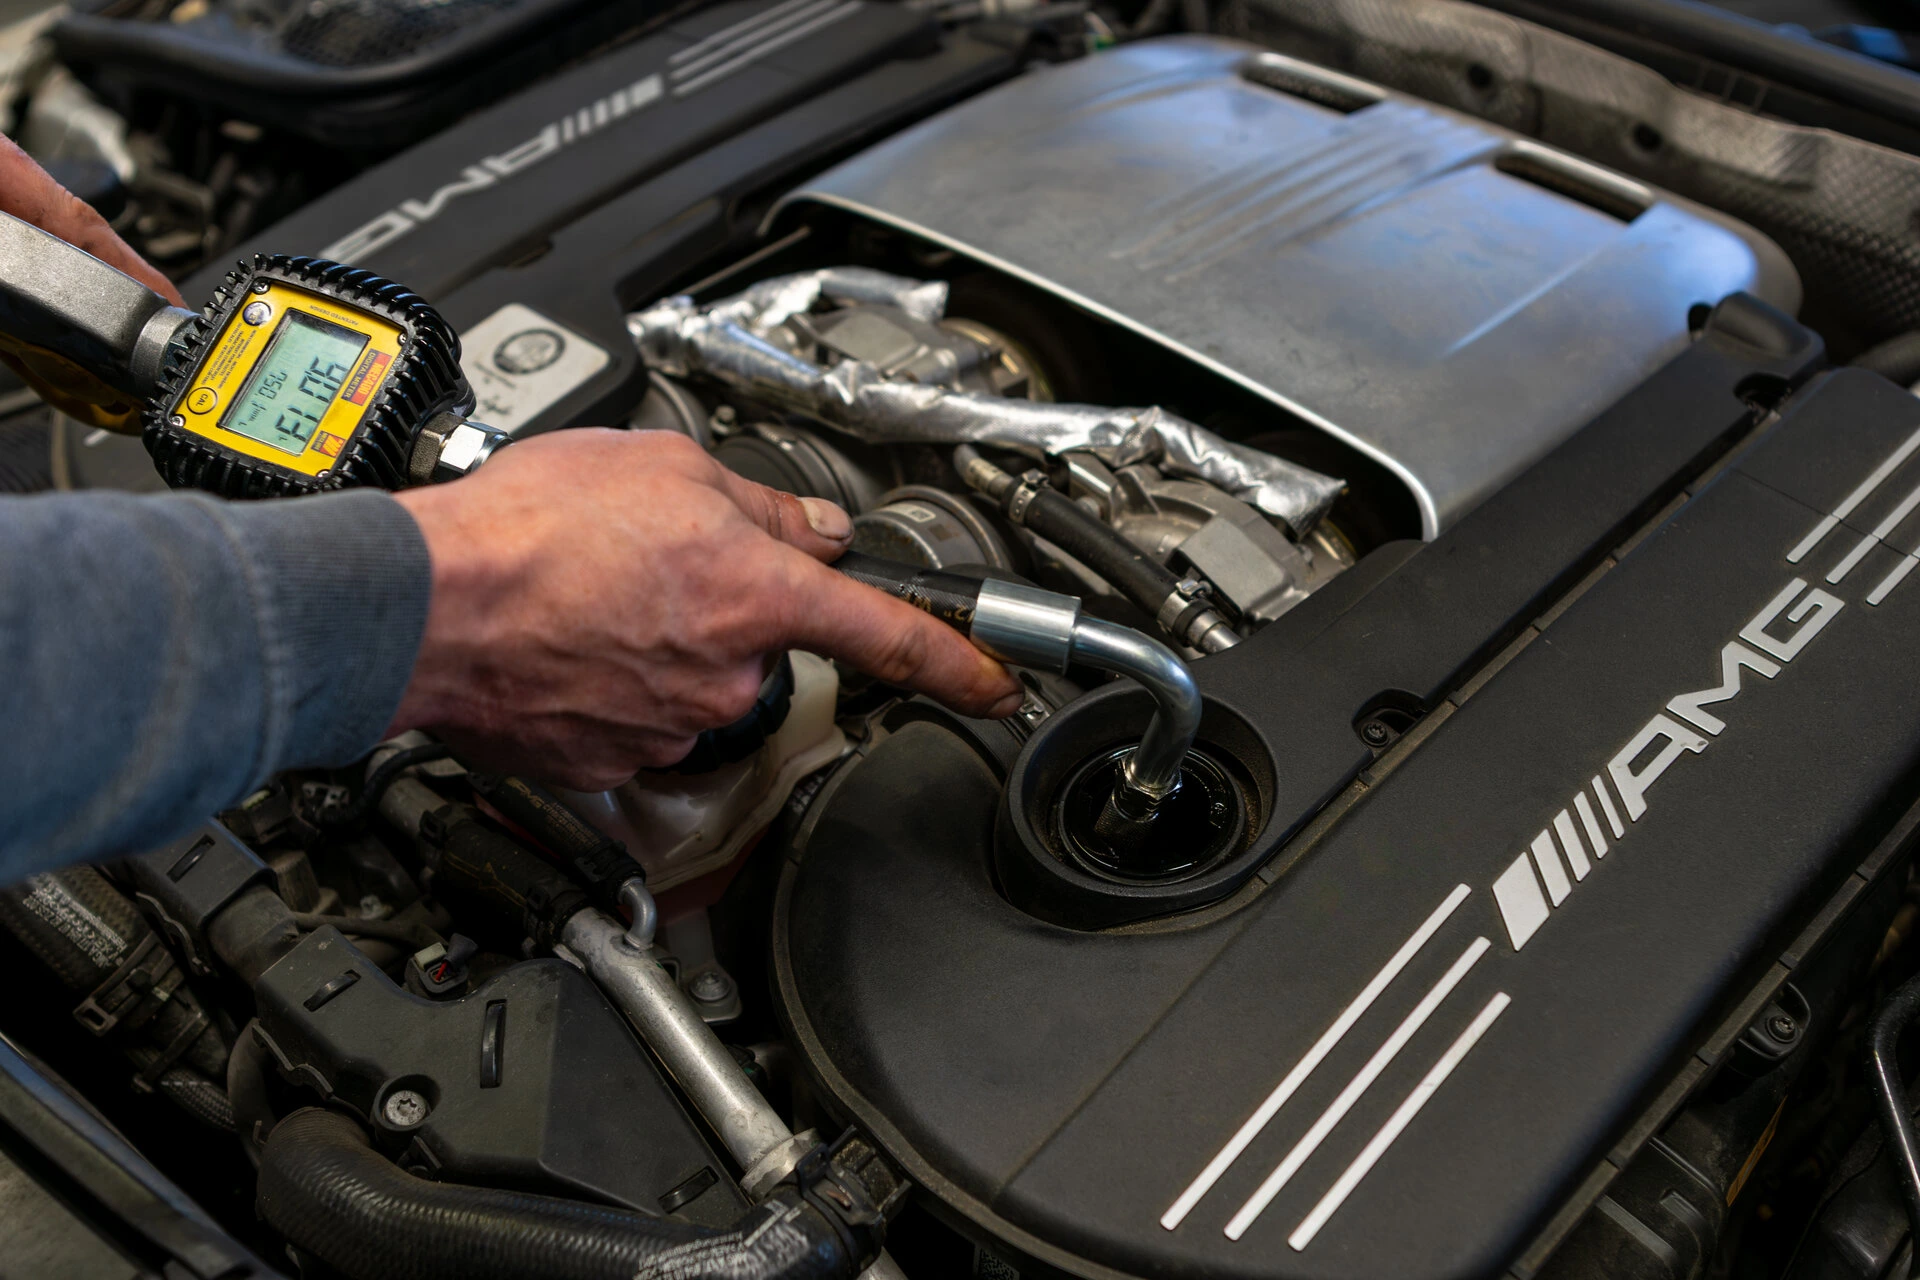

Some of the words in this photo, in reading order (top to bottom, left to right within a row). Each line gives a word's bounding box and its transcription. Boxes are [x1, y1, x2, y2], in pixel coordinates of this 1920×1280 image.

[319, 123, 559, 265] AMG
[356, 350, 376, 376] DIGITAL
[342, 374, 361, 398] METER
[356, 361, 383, 396] MEC400
[194, 392, 208, 408] CAL
[1606, 577, 1845, 822] AMG
